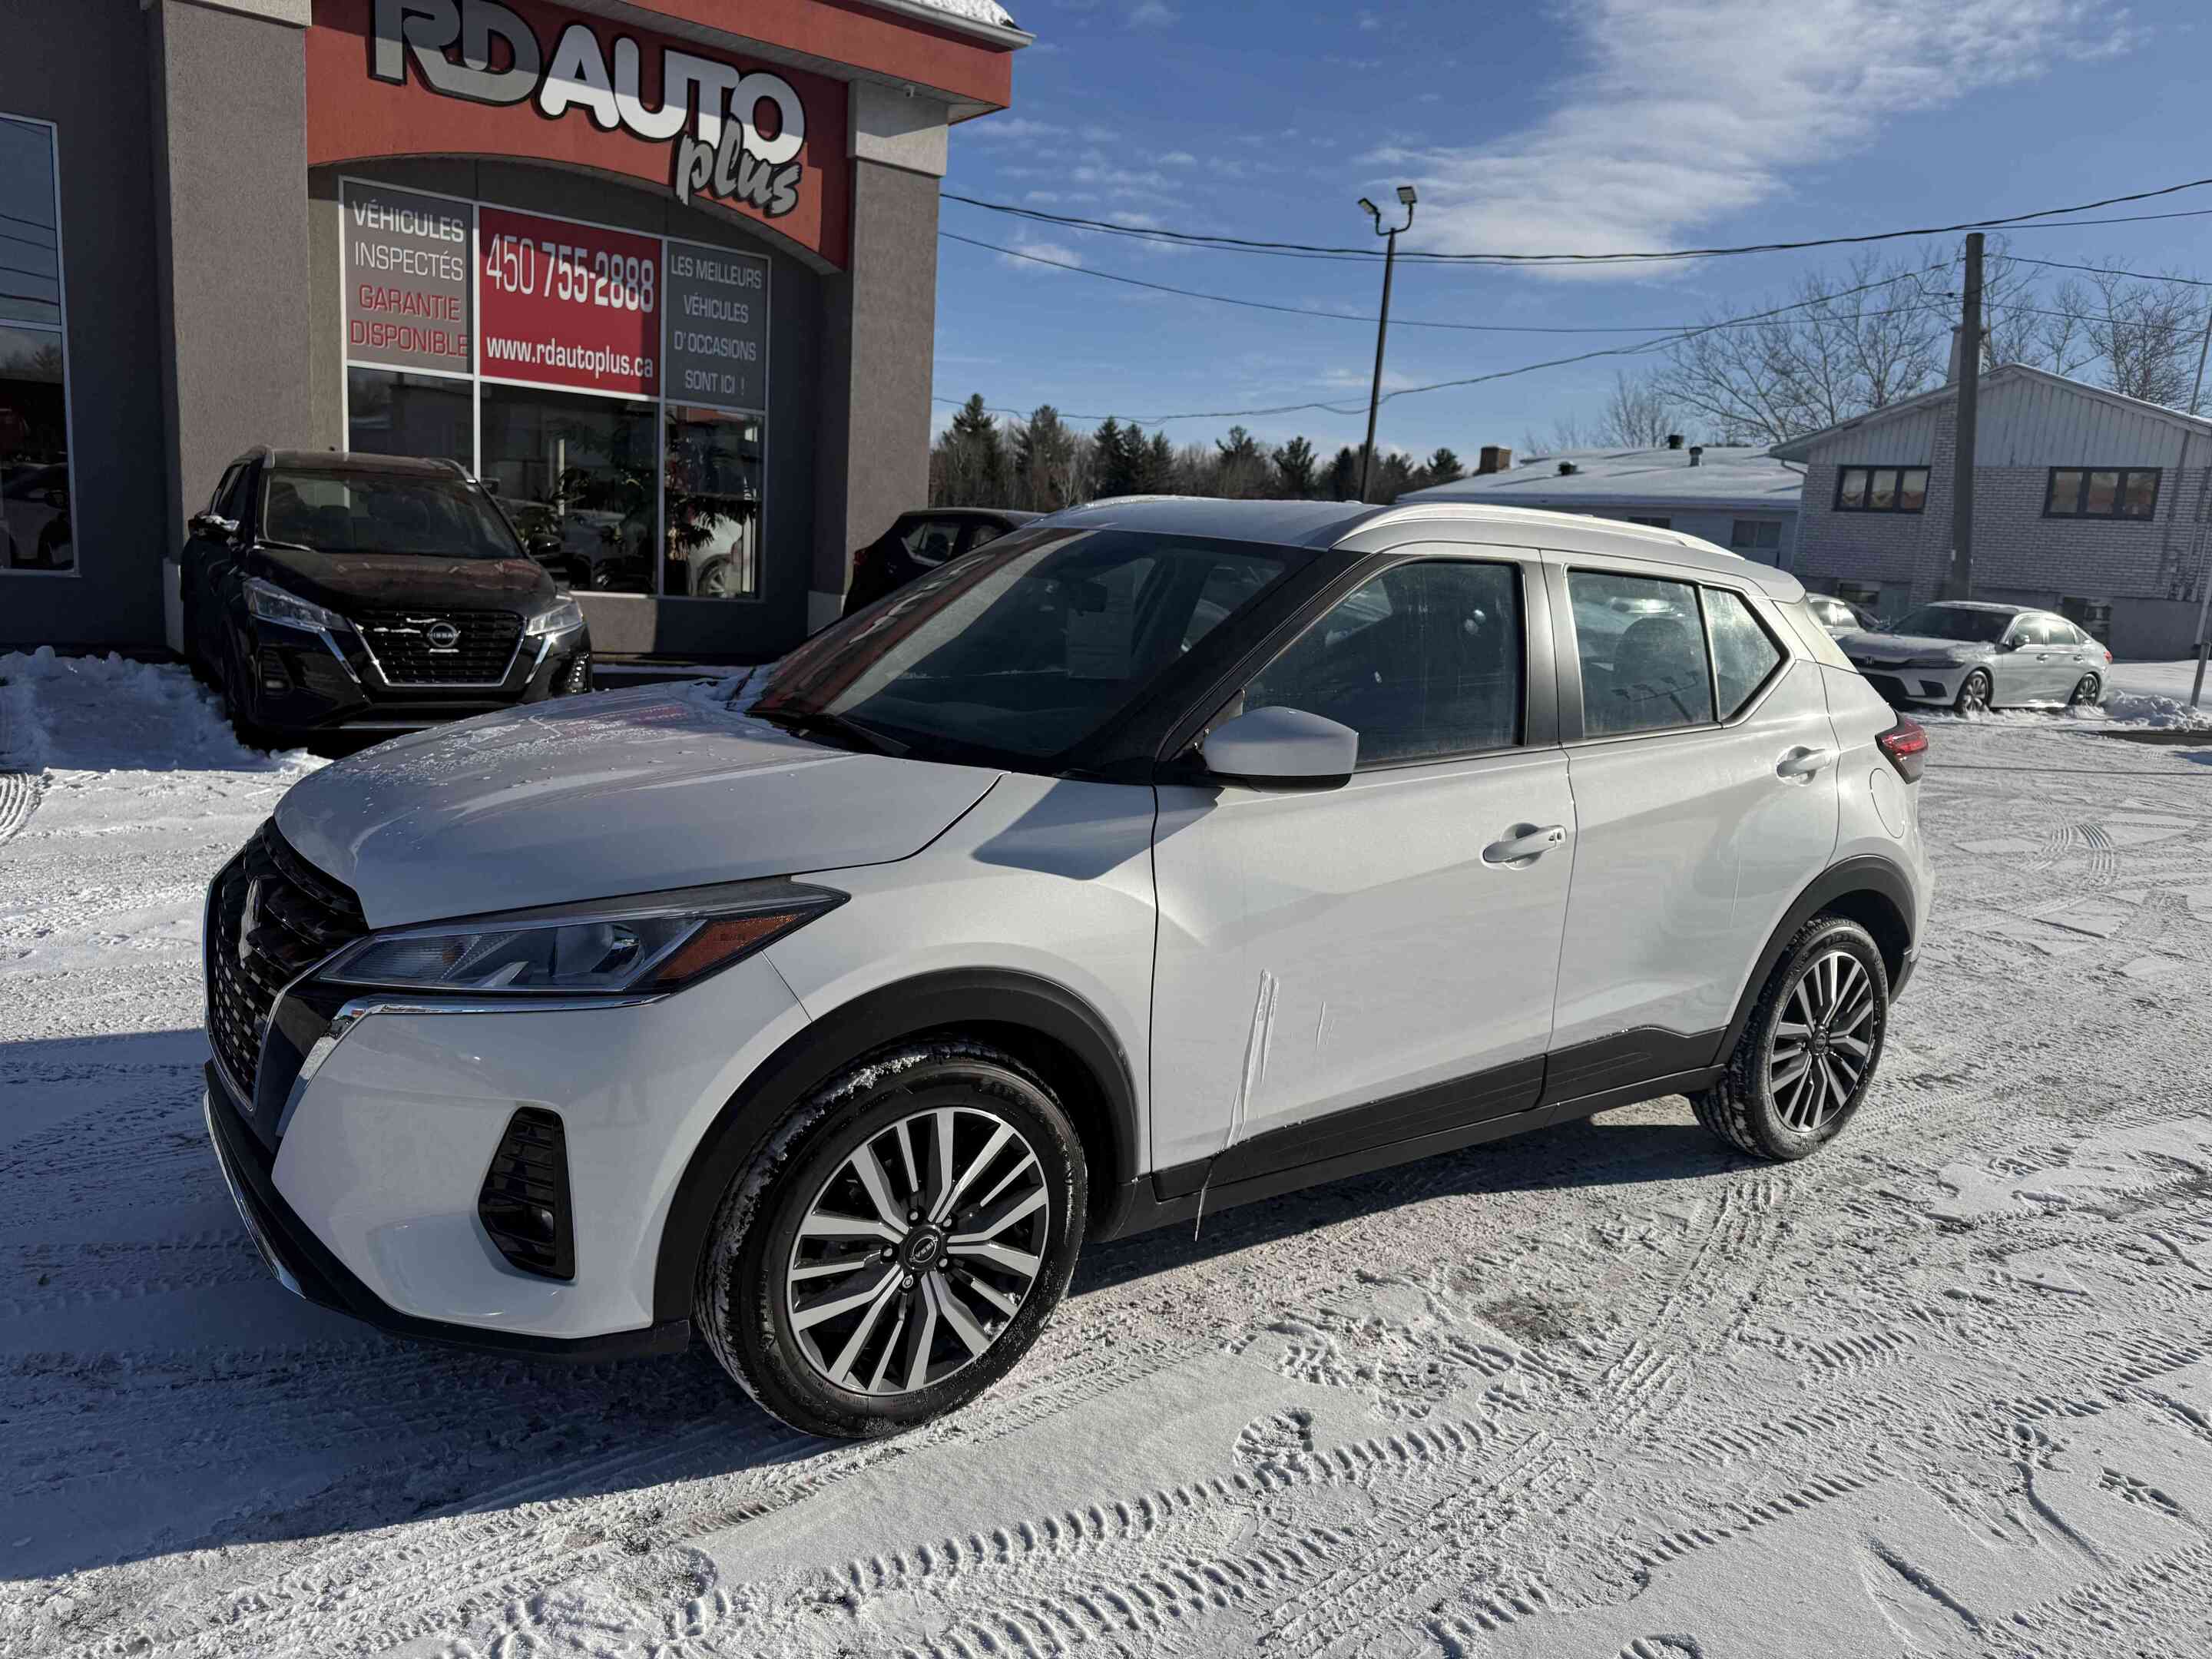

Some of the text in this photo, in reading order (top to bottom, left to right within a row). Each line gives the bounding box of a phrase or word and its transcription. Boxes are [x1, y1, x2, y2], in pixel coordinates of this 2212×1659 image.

[676, 117, 803, 215] plus
[352, 200, 465, 243] VÉHICULES
[355, 241, 464, 281] INSPECTÉS
[486, 233, 654, 313] 450 755-2888
[671, 254, 762, 290] LES MEILLEURS
[359, 283, 462, 322] GARANTIE
[684, 292, 749, 324] VÉHICULES
[350, 320, 468, 358] DISPONIBLE
[486, 336, 653, 379] www.rdautoplus.ca
[674, 330, 757, 362] D'OCCASIONS
[685, 369, 719, 393] SONT
[720, 373, 736, 395] ICI
